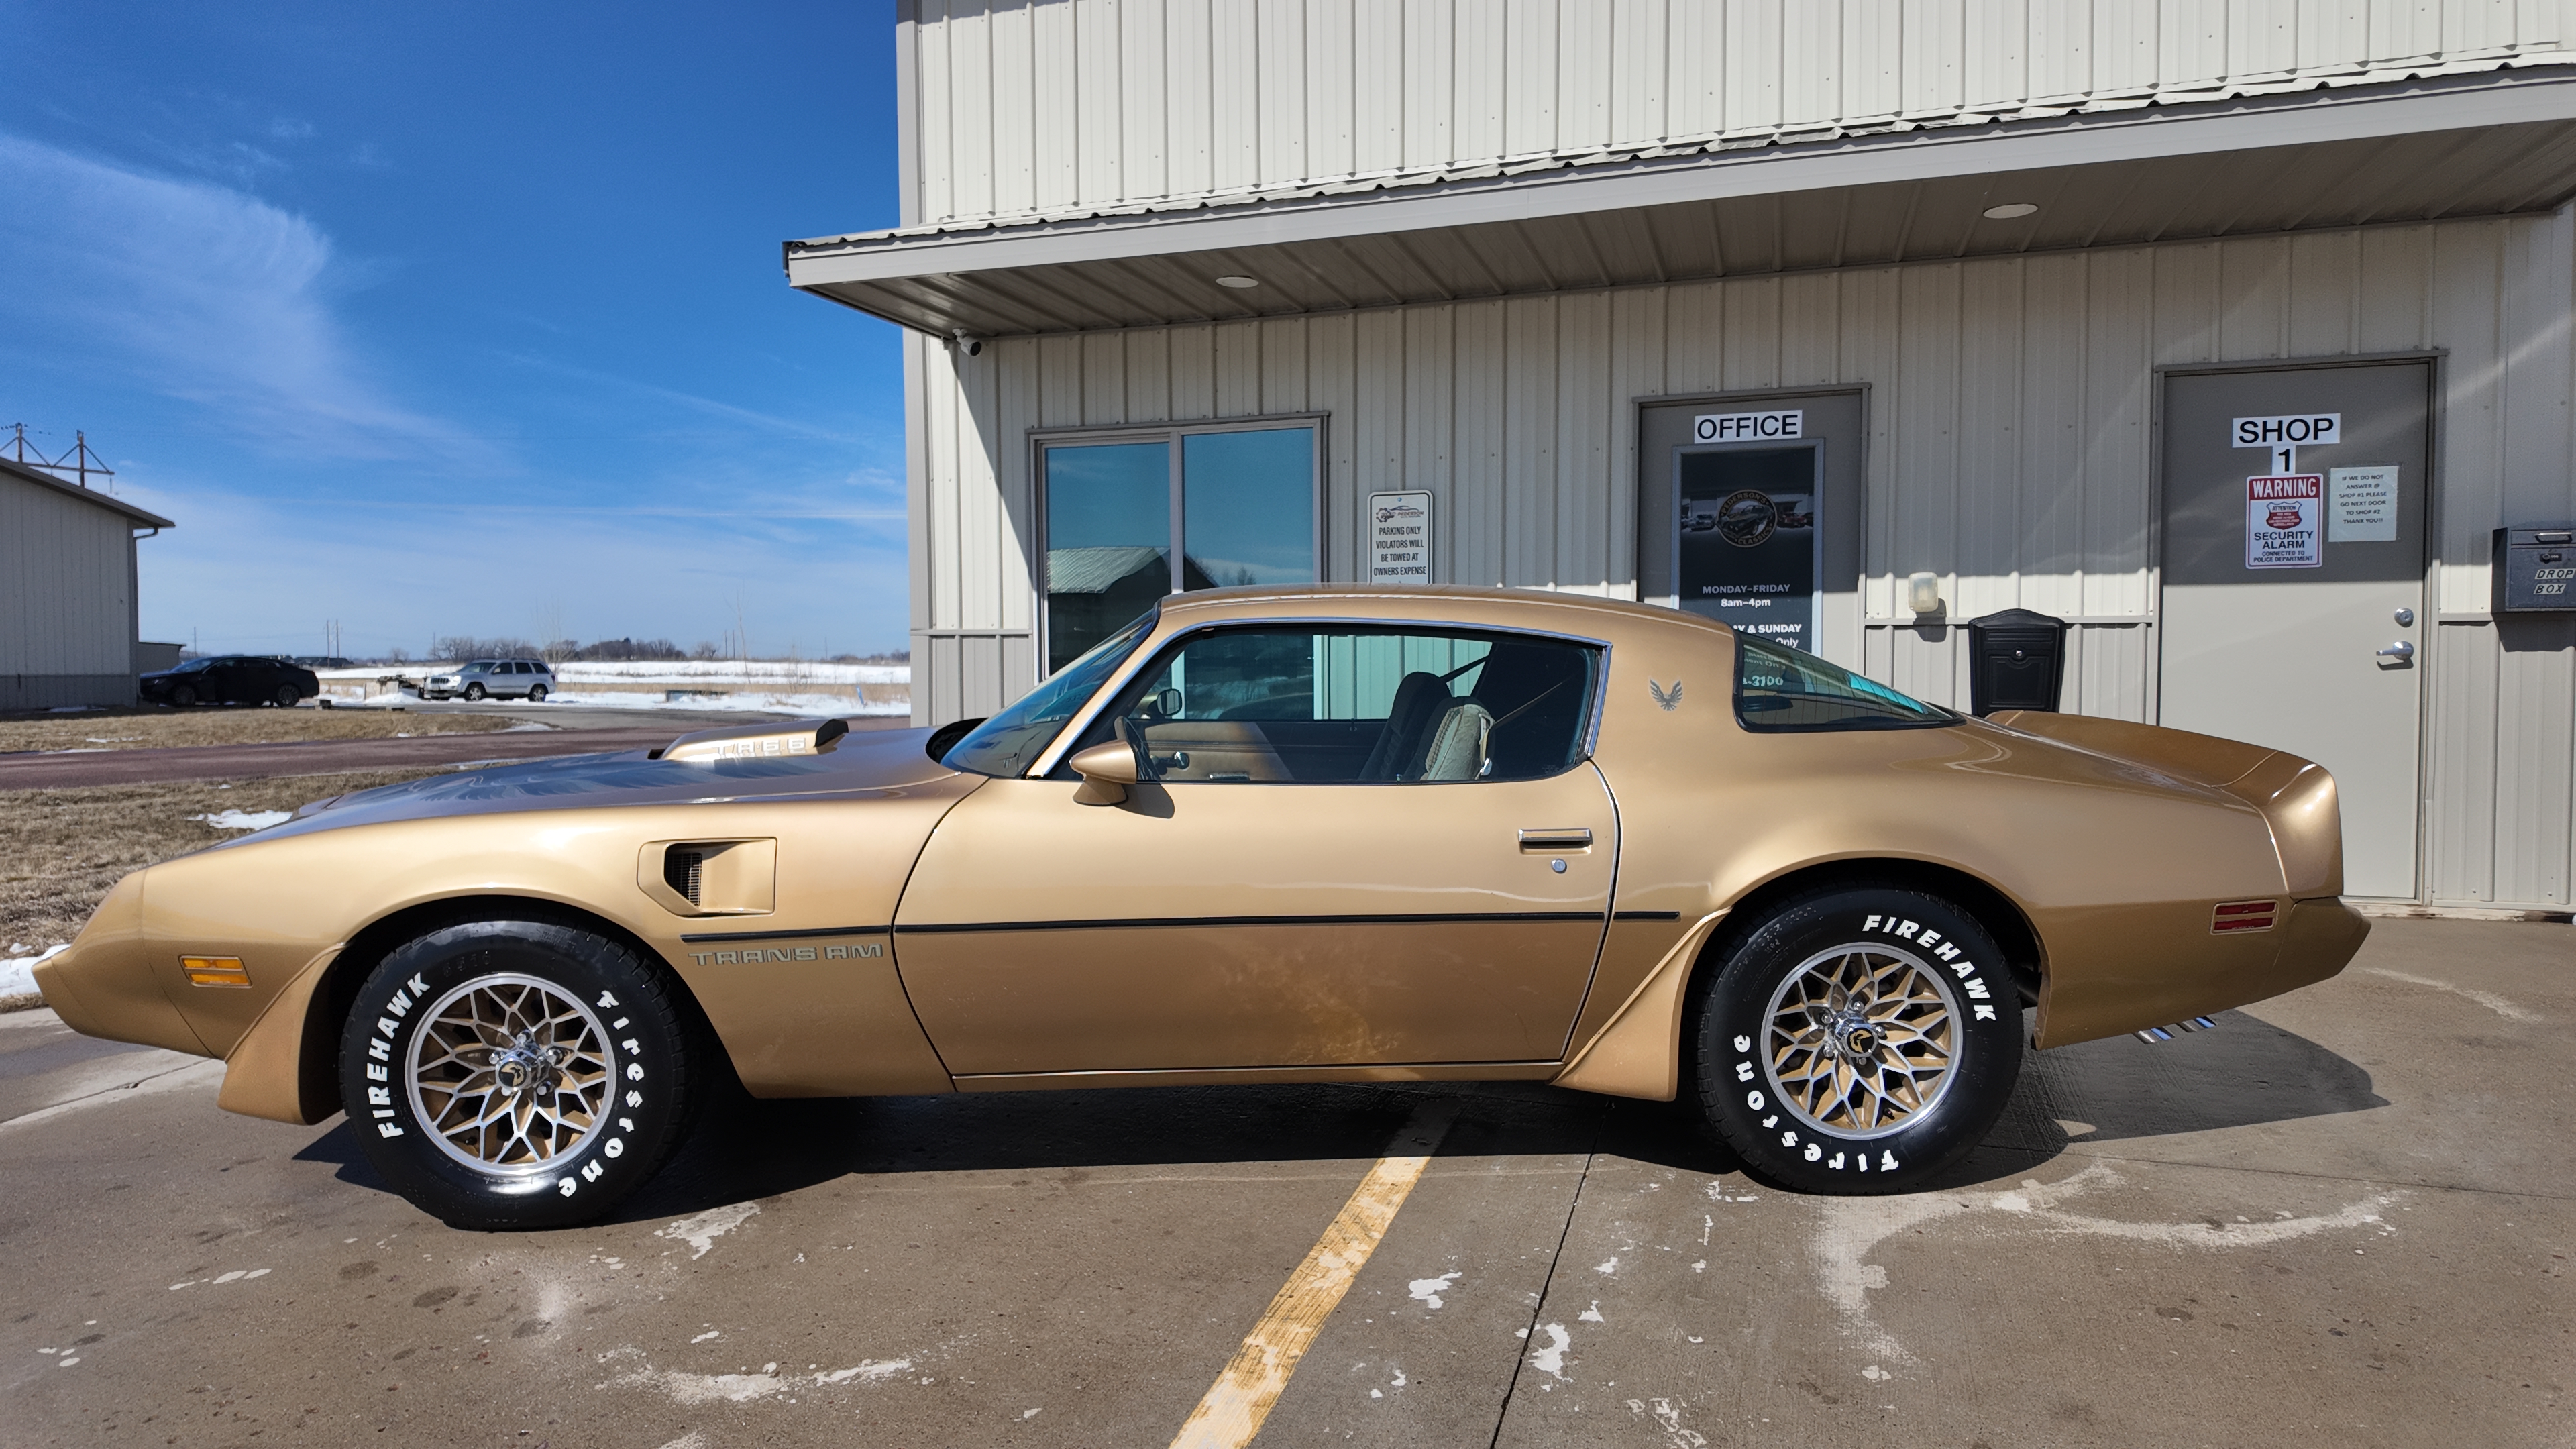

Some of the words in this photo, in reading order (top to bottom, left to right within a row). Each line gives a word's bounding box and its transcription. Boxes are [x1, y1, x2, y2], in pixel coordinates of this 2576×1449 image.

[1697, 414, 1799, 440] OFFICE
[2238, 417, 2334, 444] SHOP
[2277, 448, 2290, 472] 1
[2253, 478, 2316, 498] WARNING
[1721, 492, 1768, 514] PEDERSON'S
[1379, 526, 1405, 535] PARKING
[1406, 525, 1421, 535] ONLY
[1737, 525, 1772, 545] CLASSICS
[2254, 531, 2314, 541] SECURITY
[1376, 539, 1408, 549] VIOLATORS
[1409, 539, 1424, 548] WILL
[2262, 540, 2305, 549] ALARM
[1381, 553, 1389, 562] BE
[1389, 553, 1411, 562] TOWED
[1411, 553, 1419, 561] AT
[1373, 567, 1399, 576] OWNERS
[1400, 566, 1426, 575] EXPENSE
[2537, 570, 2573, 578] DROP
[2536, 585, 2563, 593] BOX
[1747, 624, 1756, 633] &
[1758, 623, 1802, 633] SUNDAY
[1775, 637, 1799, 648] Only
[688, 947, 818, 966] TRANS
[824, 943, 884, 960] AM
[1862, 914, 1996, 1022] FIREHAWK
[366, 972, 431, 1139] FIREHAWK
[557, 989, 645, 1197] Firestone
[1733, 1034, 1900, 1173] Firestone
